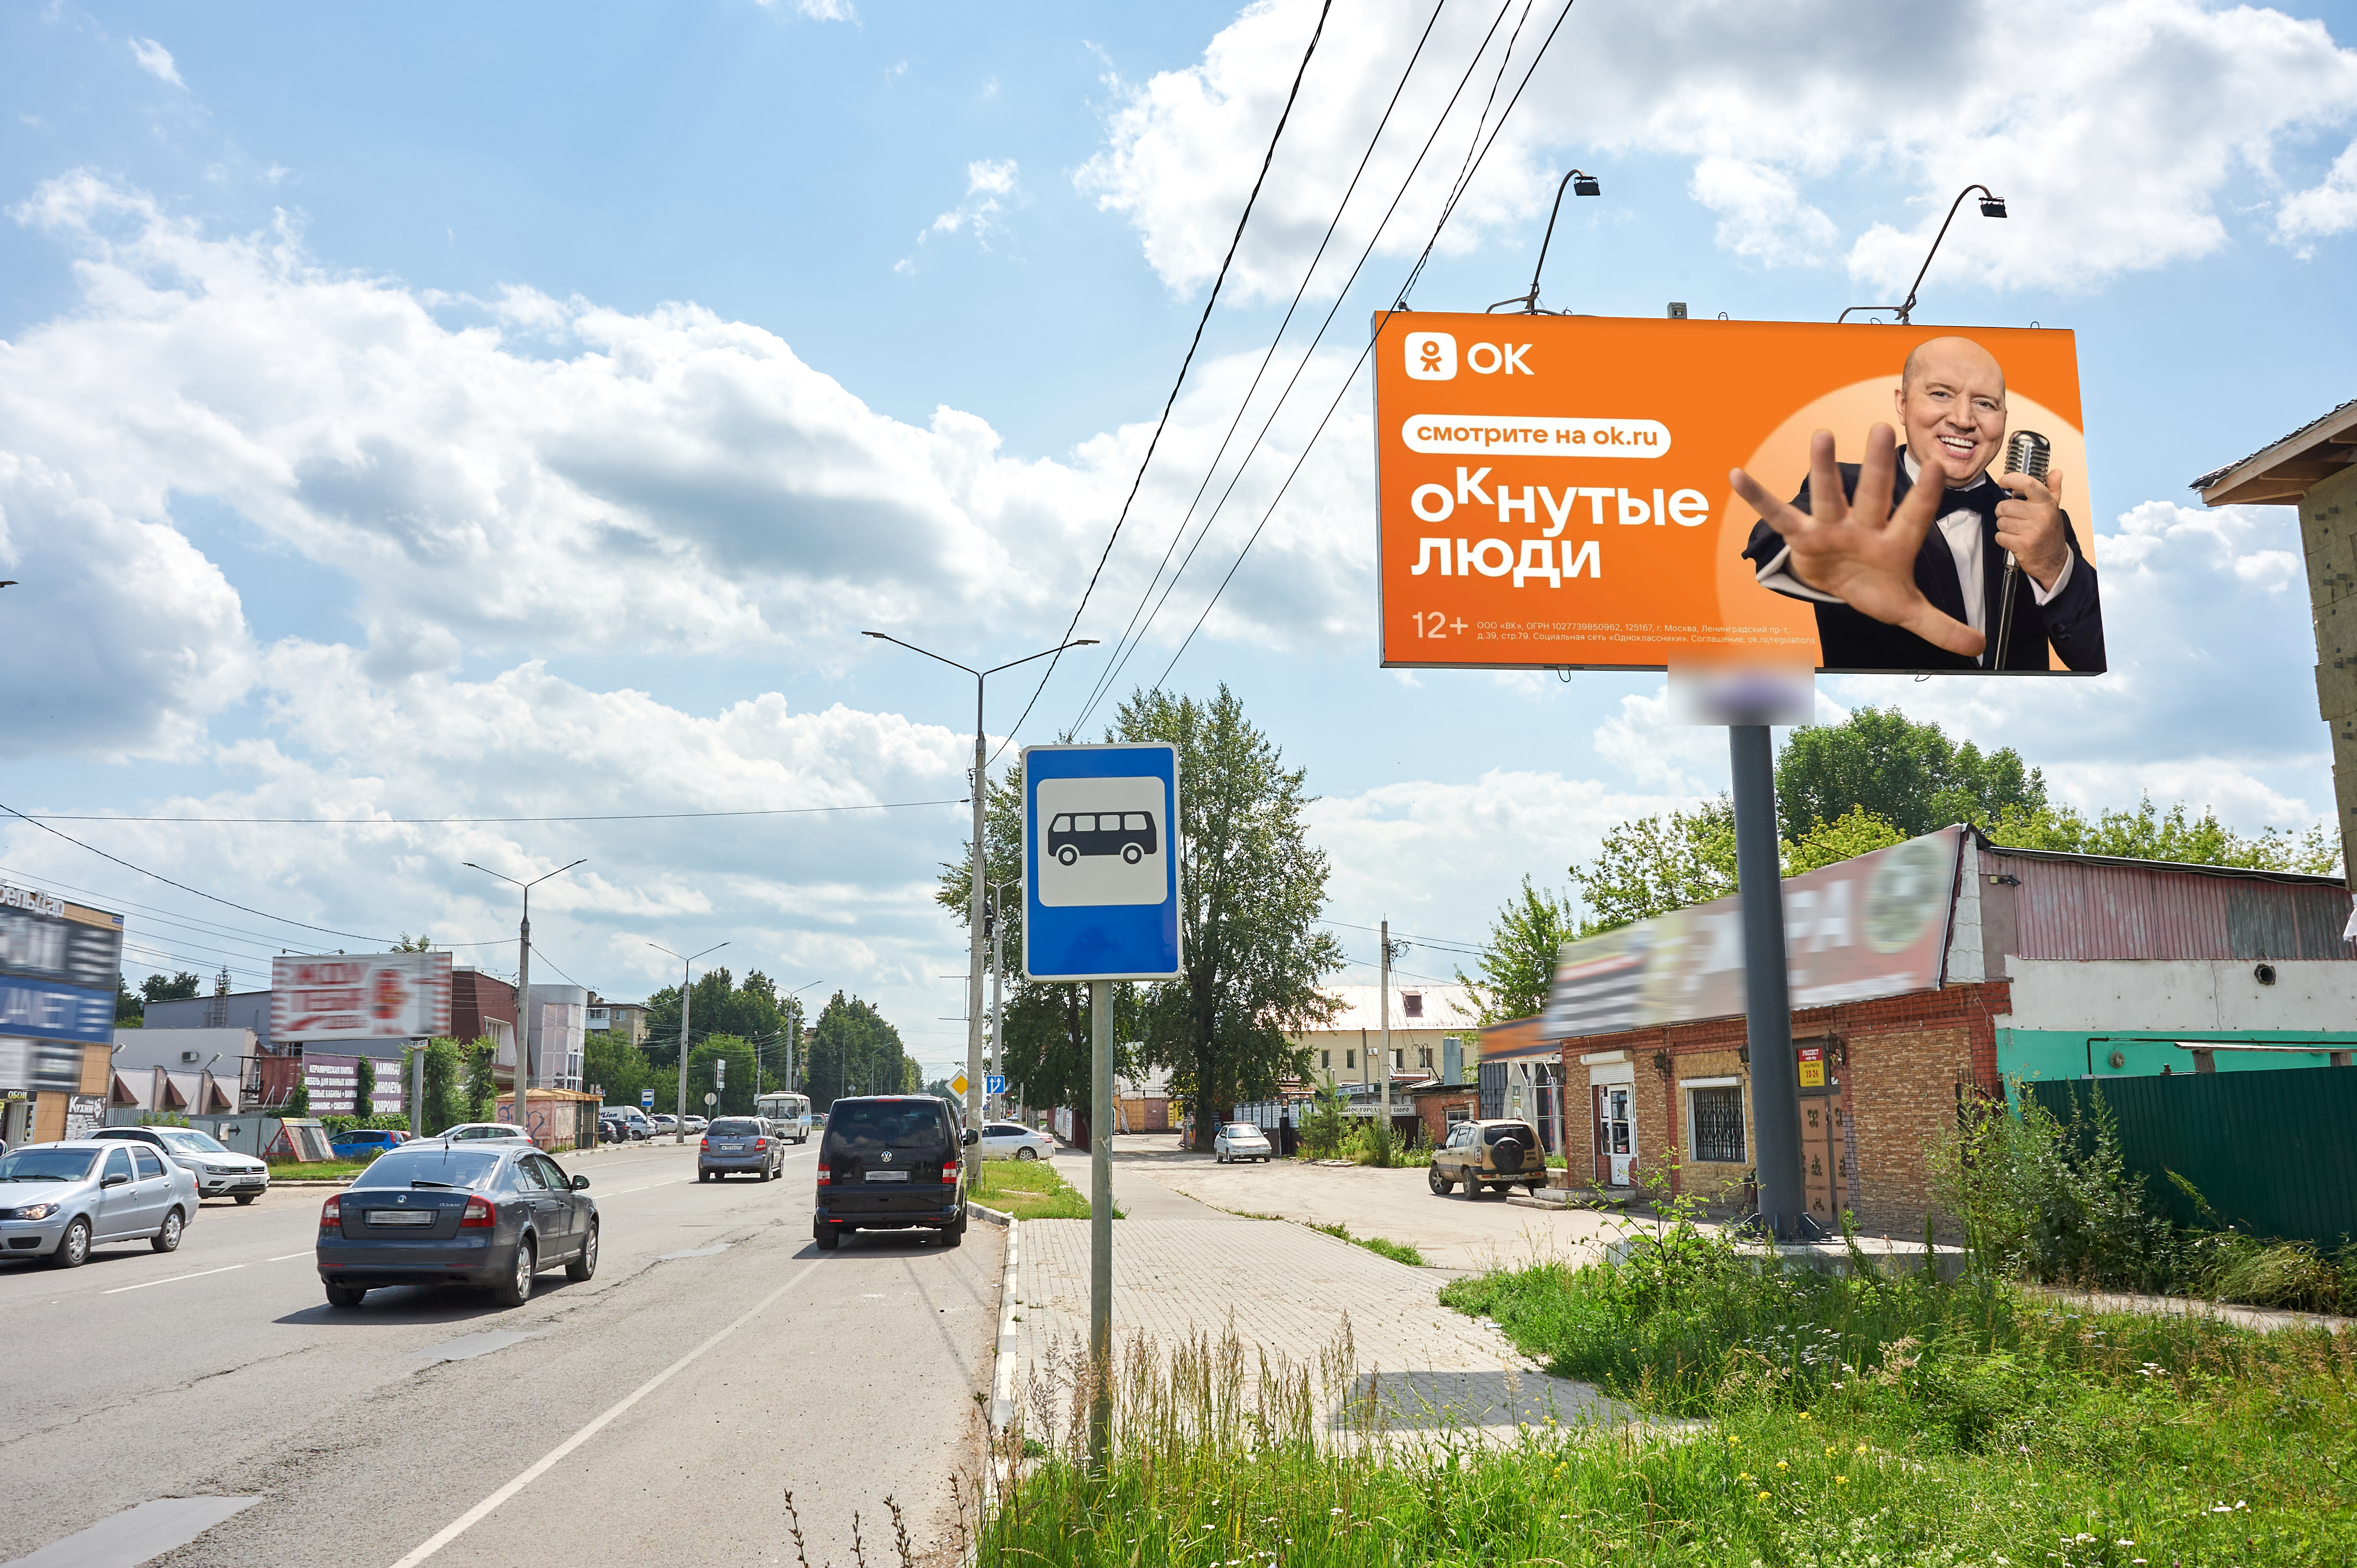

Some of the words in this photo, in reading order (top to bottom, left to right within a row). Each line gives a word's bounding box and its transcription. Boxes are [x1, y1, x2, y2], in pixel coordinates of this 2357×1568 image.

[1467, 342, 1535, 375] ОК
[1417, 426, 1548, 447] смотрите
[1556, 429, 1585, 445] на
[1593, 426, 1657, 446] ok.ru
[1411, 537, 1601, 589] люди
[1412, 611, 1469, 639] 12+
[1500, 622, 1524, 630] «ВК»,
[1552, 623, 1622, 631] 1027739850962,
[1625, 624, 1654, 633] 125167,
[1664, 625, 1699, 633] Москва,
[1701, 625, 1767, 635] Ленинградский
[1770, 628, 1789, 636] пр-т,
[1477, 632, 1499, 640] д.39,
[1502, 633, 1531, 641] стр.79.
[1533, 633, 1585, 641] Социальная
[1609, 634, 1689, 643] «Одноклассники».
[1691, 635, 1746, 643] Соглашение:
[1748, 636, 1815, 645] ok.ru/regulations
[310, 1064, 340, 1074] КЕРАМИЧЕСКАЯ
[375, 1062, 401, 1075] ЛАМИНАТ
[1806, 1070, 1819, 1078] 10-24
[8, 1090, 28, 1099] ОБОИ
[373, 1100, 401, 1112] КОВРОЛИН
